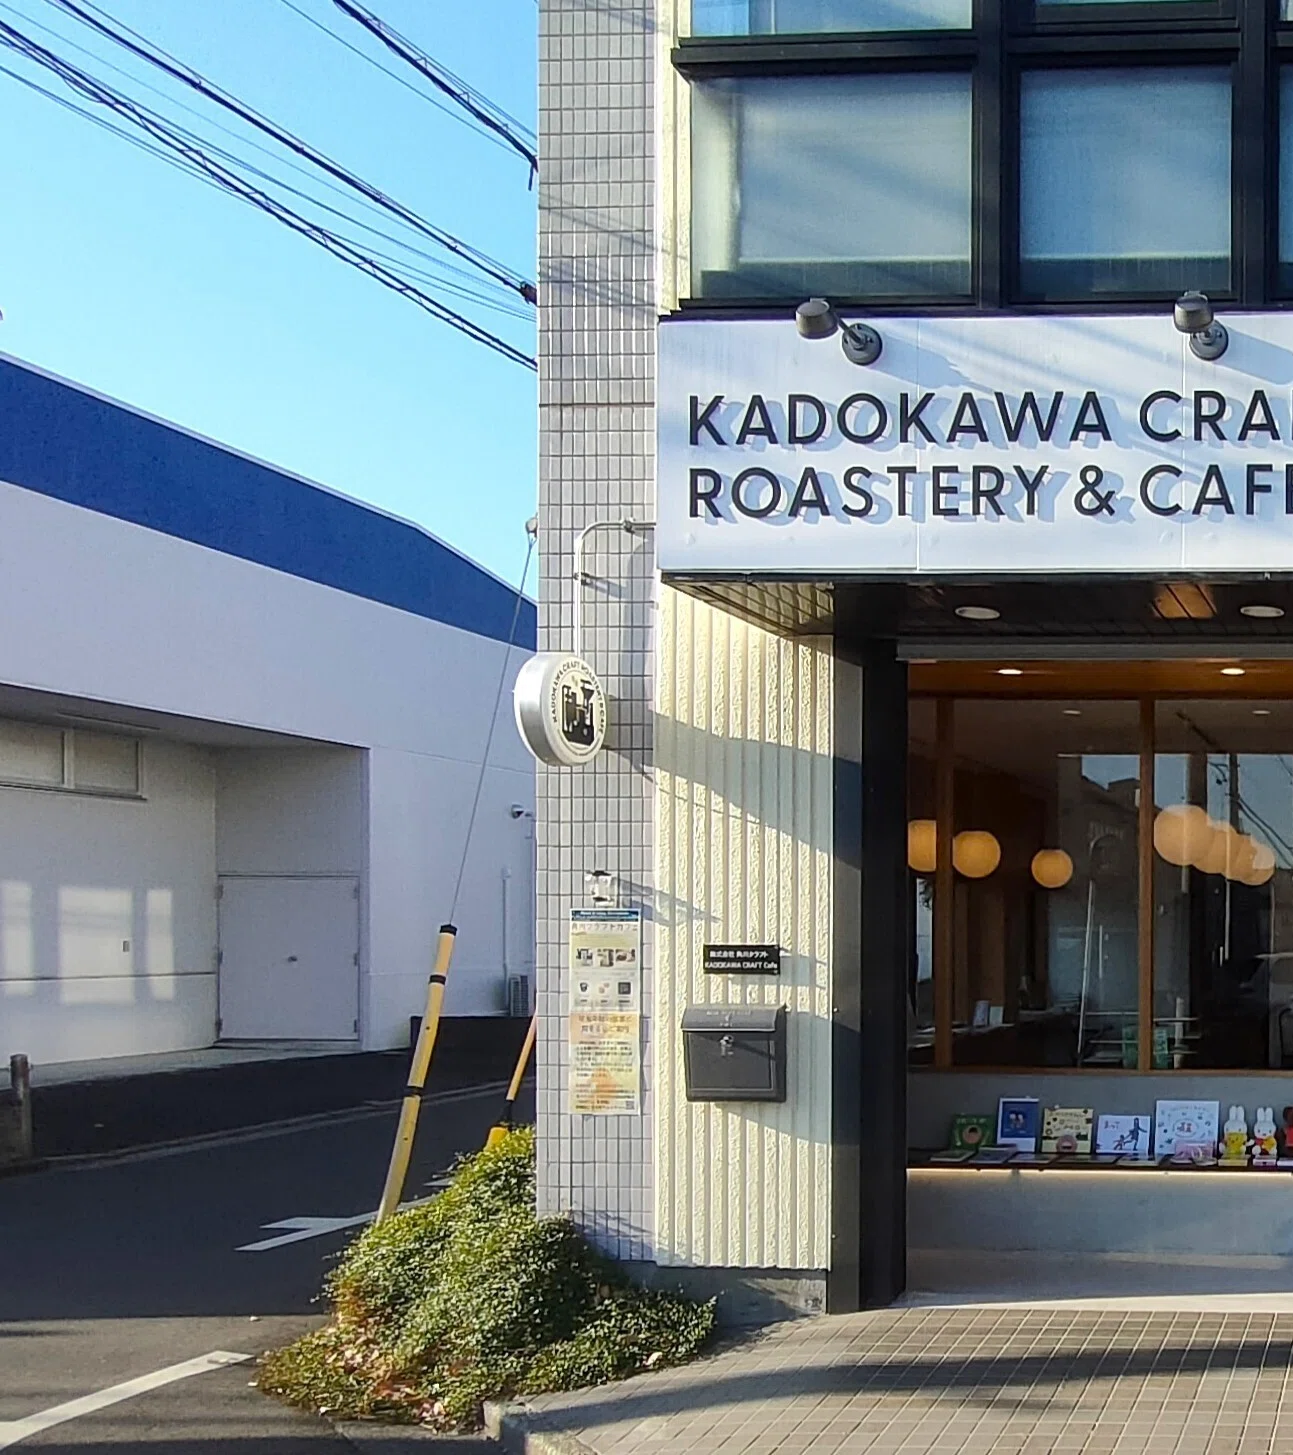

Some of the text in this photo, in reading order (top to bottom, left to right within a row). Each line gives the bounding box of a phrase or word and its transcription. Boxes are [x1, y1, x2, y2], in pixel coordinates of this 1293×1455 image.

[689, 391, 1112, 446] KADOKAWA
[689, 465, 1049, 519] ROASTERY
[1074, 465, 1116, 516] &
